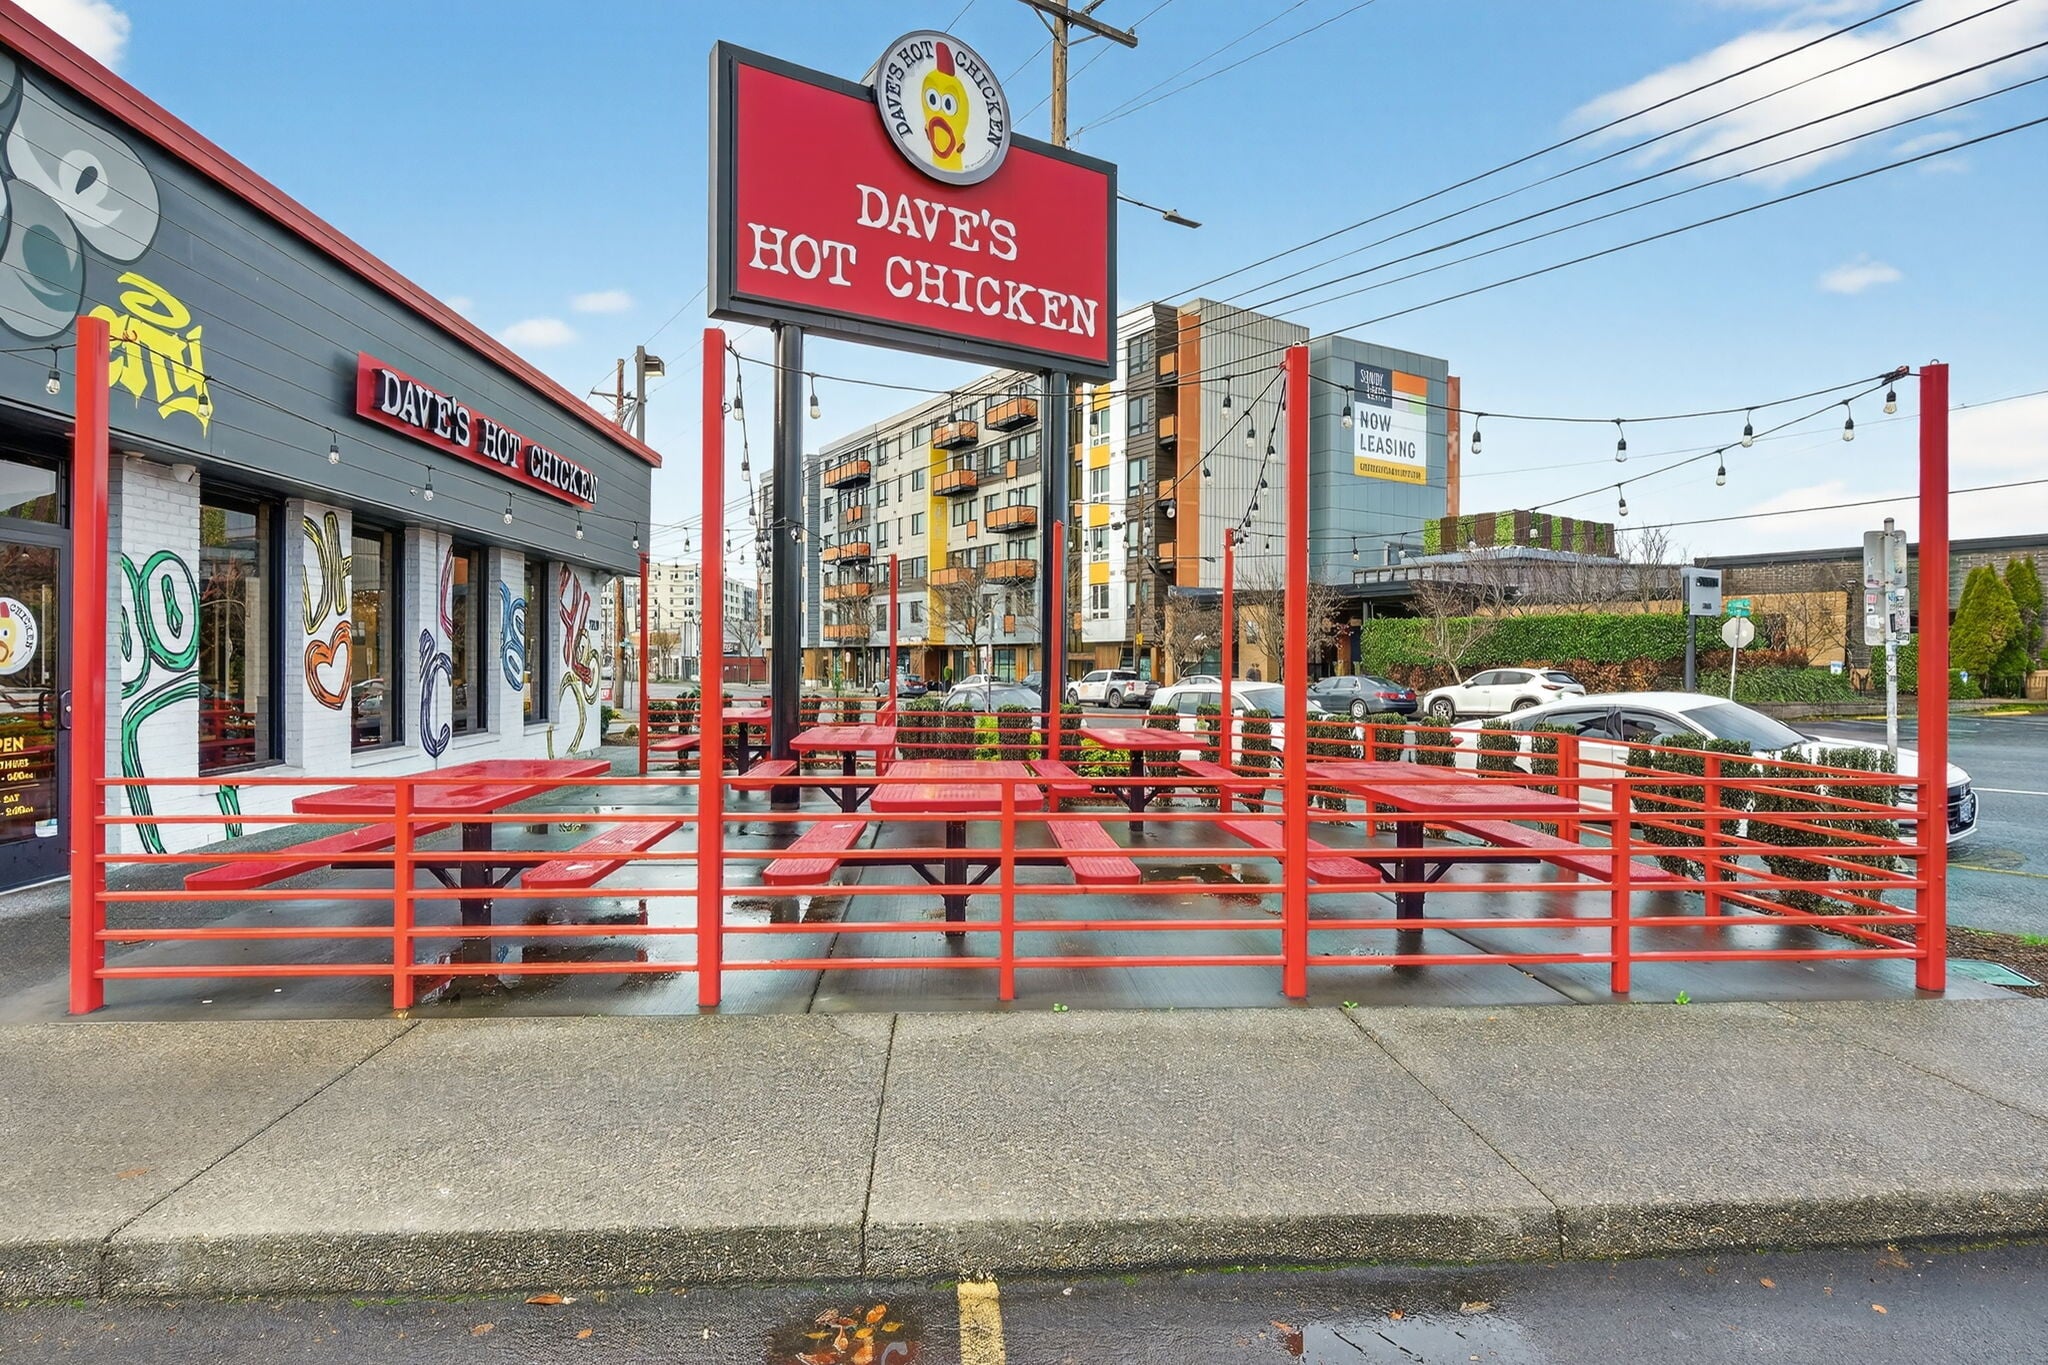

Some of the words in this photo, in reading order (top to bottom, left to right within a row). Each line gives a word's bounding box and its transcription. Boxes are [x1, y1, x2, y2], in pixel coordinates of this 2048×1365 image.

[897, 40, 934, 68] HOT
[885, 62, 913, 139] DAVE'S
[955, 50, 1004, 149] CHICKEN
[856, 183, 1017, 261] DAVE'S
[748, 222, 857, 287] HOT
[885, 255, 1099, 338] CHICKEN
[380, 368, 471, 448] DAVE'S
[482, 418, 522, 469] HOT
[530, 445, 600, 504] CHICKEN
[1360, 410, 1392, 433] NOW
[1360, 433, 1416, 459] LEASING
